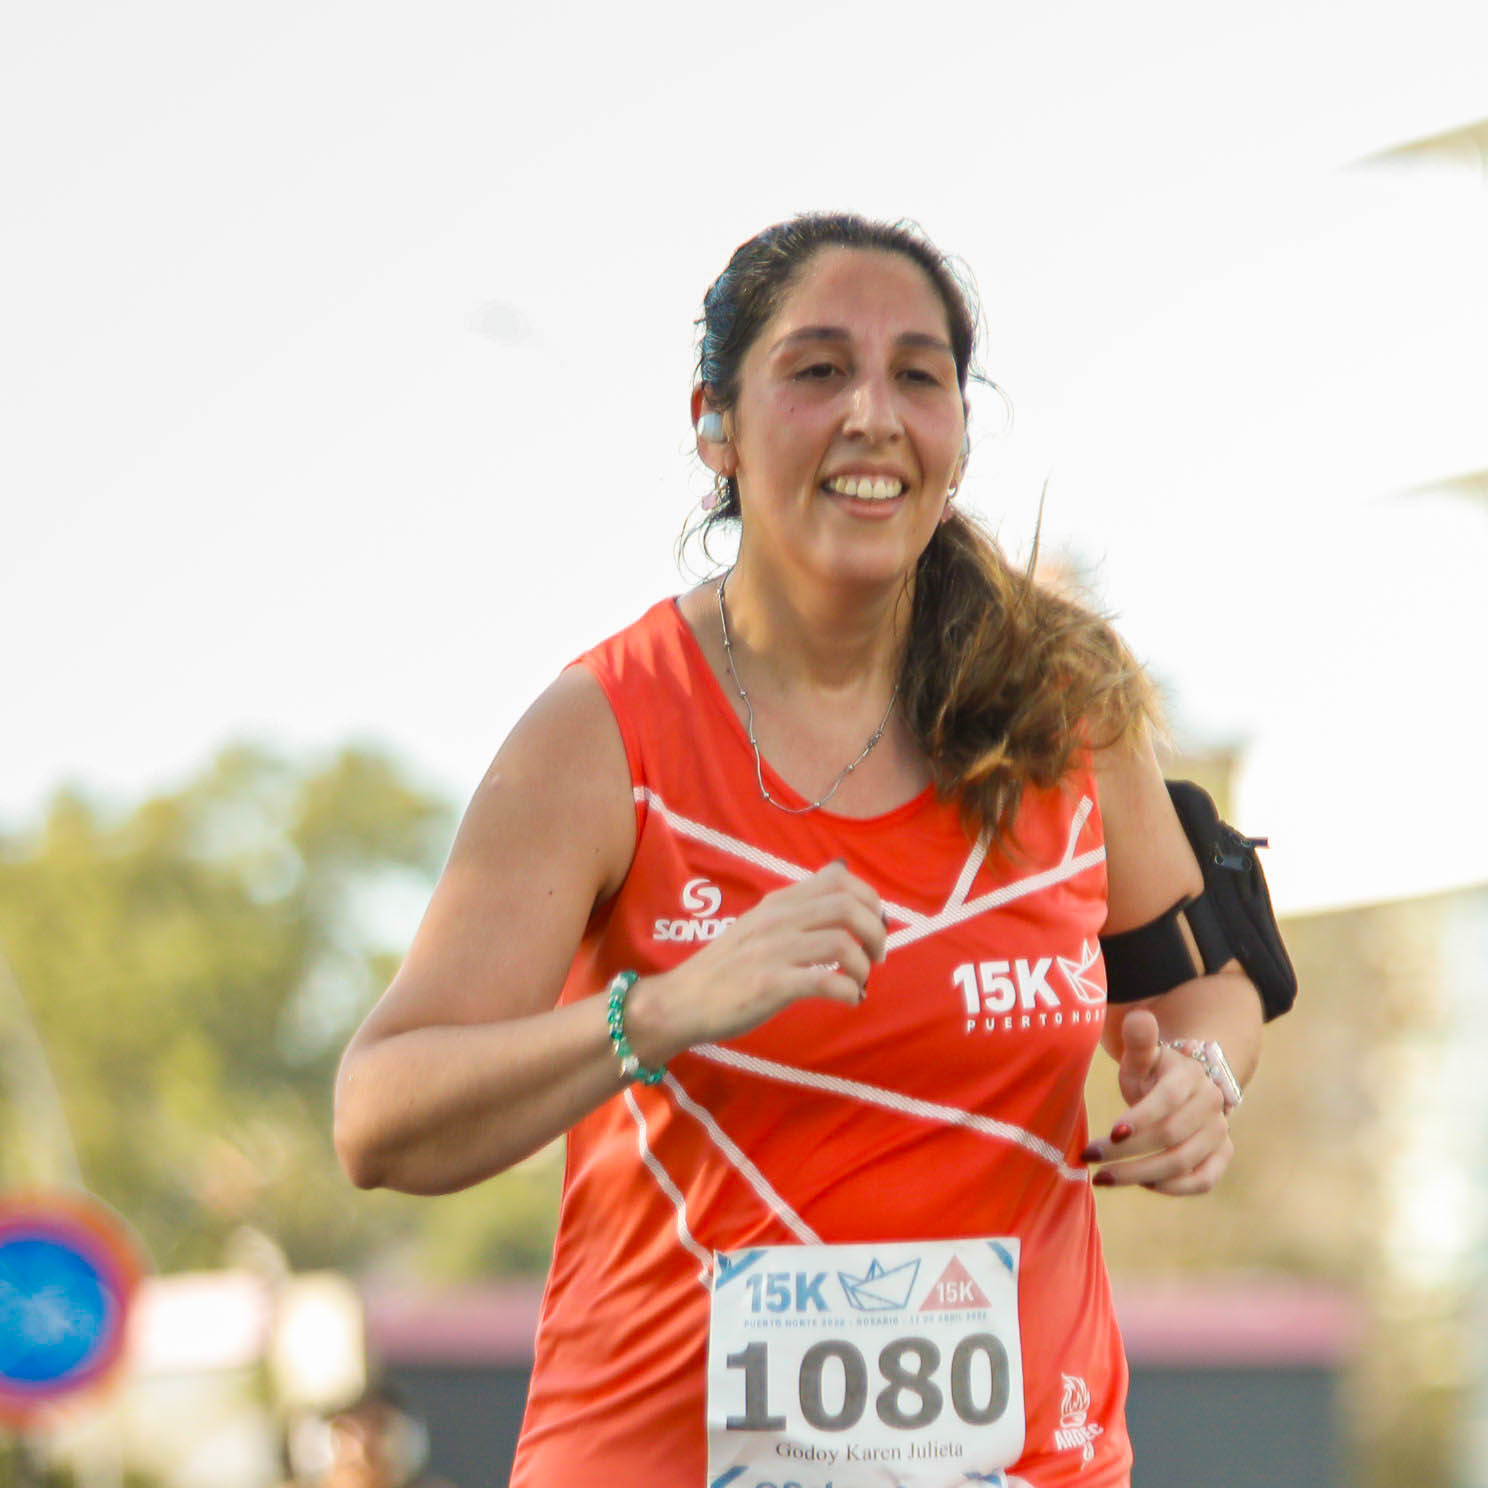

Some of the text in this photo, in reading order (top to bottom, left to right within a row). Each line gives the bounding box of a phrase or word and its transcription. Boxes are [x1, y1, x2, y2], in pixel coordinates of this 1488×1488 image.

[953, 957, 1061, 1014] 15K
[966, 1013, 1064, 1033] PUERTO
[745, 1271, 830, 1313] 15K
[936, 1279, 975, 1303] 15K
[726, 1333, 1010, 1432] 1080
[775, 1440, 963, 1465] Godoy Karen Julieta
